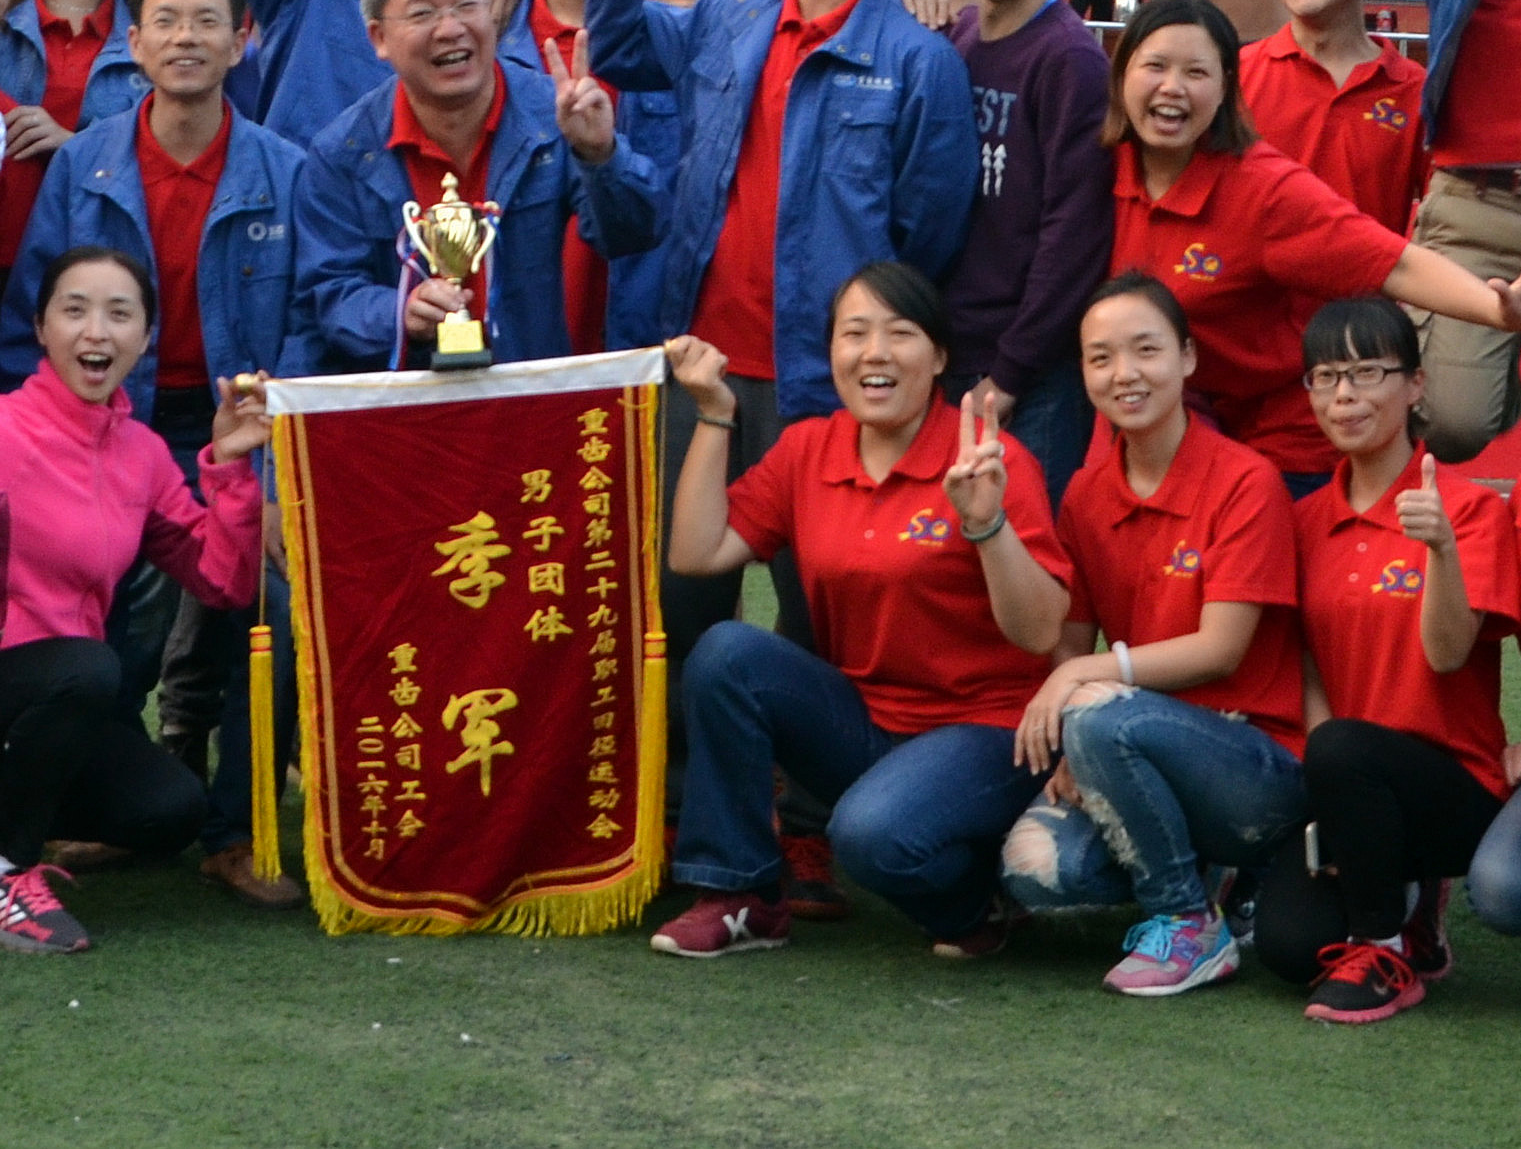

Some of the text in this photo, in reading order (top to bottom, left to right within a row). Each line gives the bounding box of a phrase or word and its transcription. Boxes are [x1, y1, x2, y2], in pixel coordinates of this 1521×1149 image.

[431, 510, 520, 797] 季军
[520, 469, 574, 643] 男子团体
[576, 407, 624, 839] 重齿公司第二十九届职工田径运动会
[387, 642, 427, 838] 重齿公司工会
